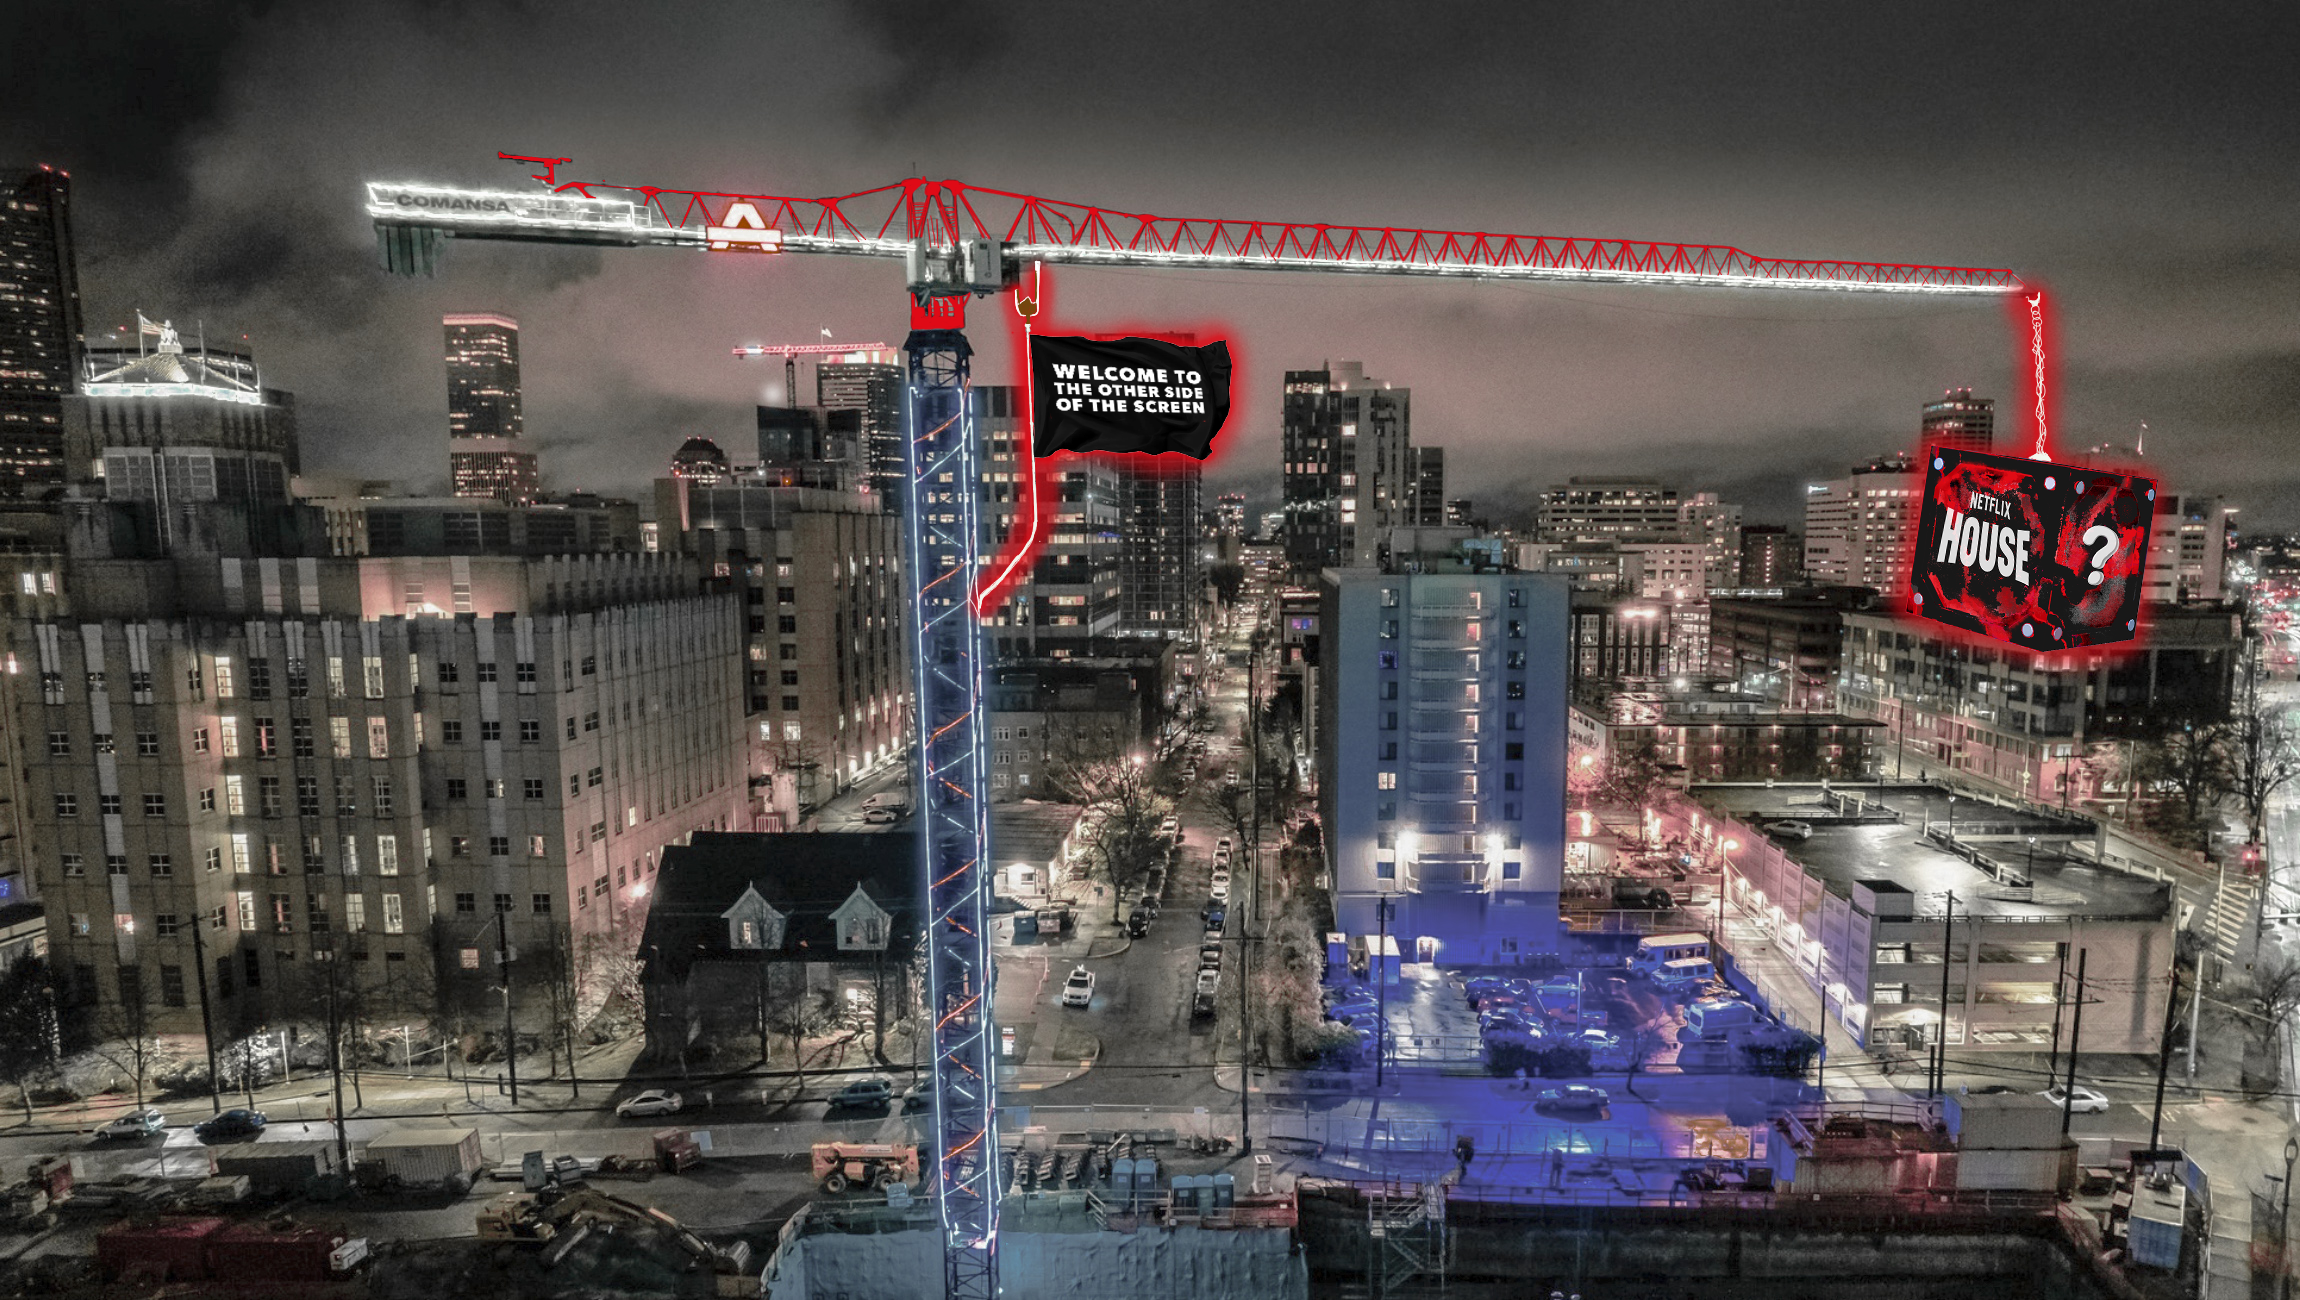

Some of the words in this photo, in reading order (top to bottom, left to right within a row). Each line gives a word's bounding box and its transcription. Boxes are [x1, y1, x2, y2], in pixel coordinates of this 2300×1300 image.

[396, 193, 512, 213] COMANSA
[1053, 364, 1168, 383] WELCOME
[1174, 370, 1201, 384] TO
[1054, 382, 1092, 395] THE
[1098, 384, 1160, 397] OTHER
[1165, 387, 1203, 398] SIDE
[1056, 398, 1082, 411] OF
[1089, 399, 1127, 412] THE
[1133, 400, 1205, 413] SCREEN
[1969, 491, 2012, 521] NETFLIX
[1936, 506, 2031, 587] HOUSE
